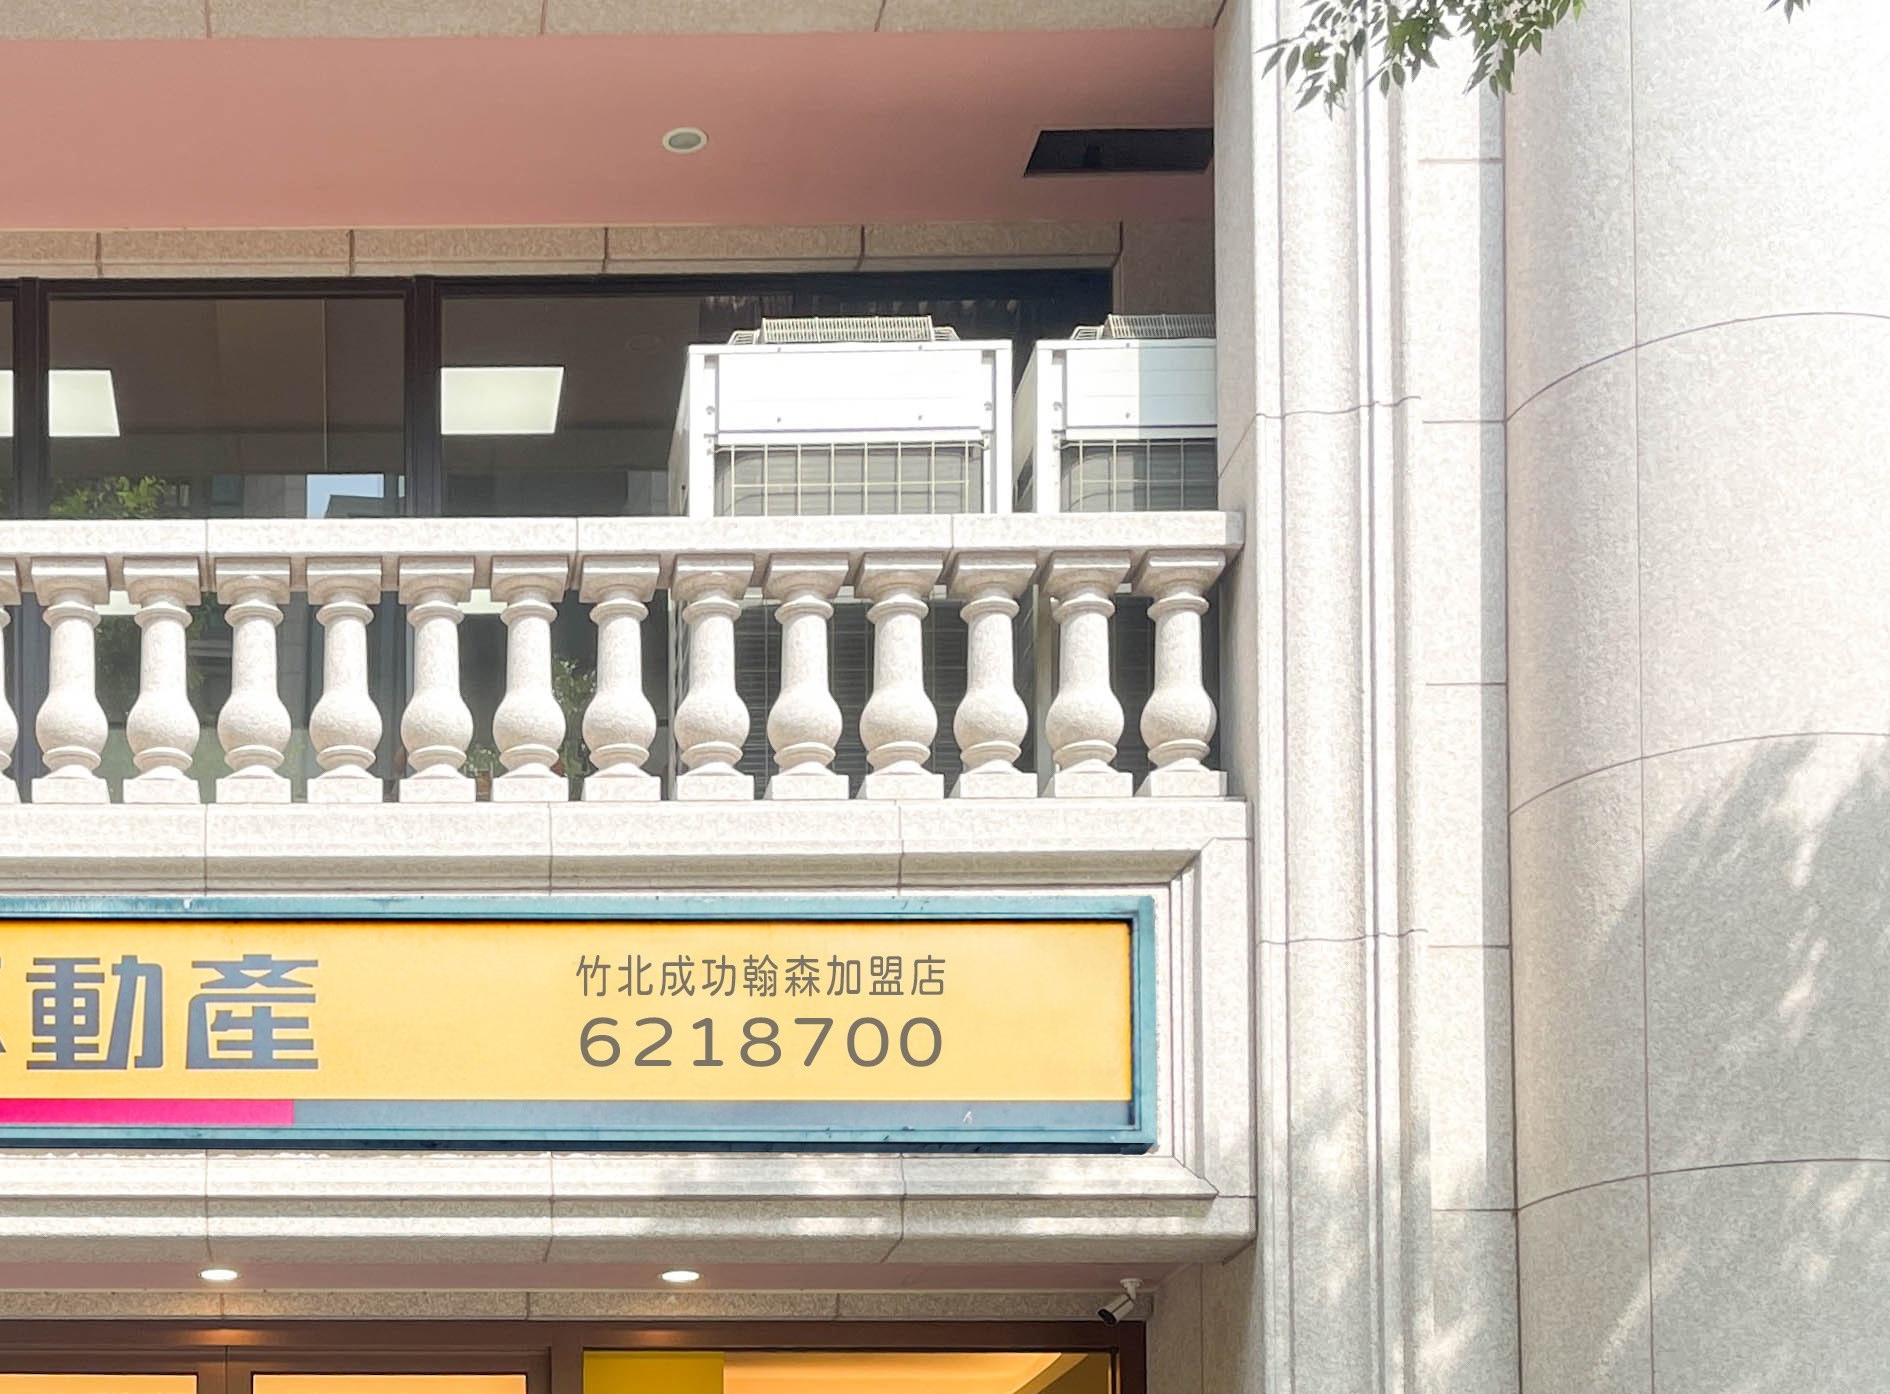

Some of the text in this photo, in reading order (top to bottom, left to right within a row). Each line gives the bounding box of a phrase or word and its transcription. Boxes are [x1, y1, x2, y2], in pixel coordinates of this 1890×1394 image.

[575, 954, 947, 997] 竹北成功翰森加盟店
[579, 1016, 943, 1068] 6218700
